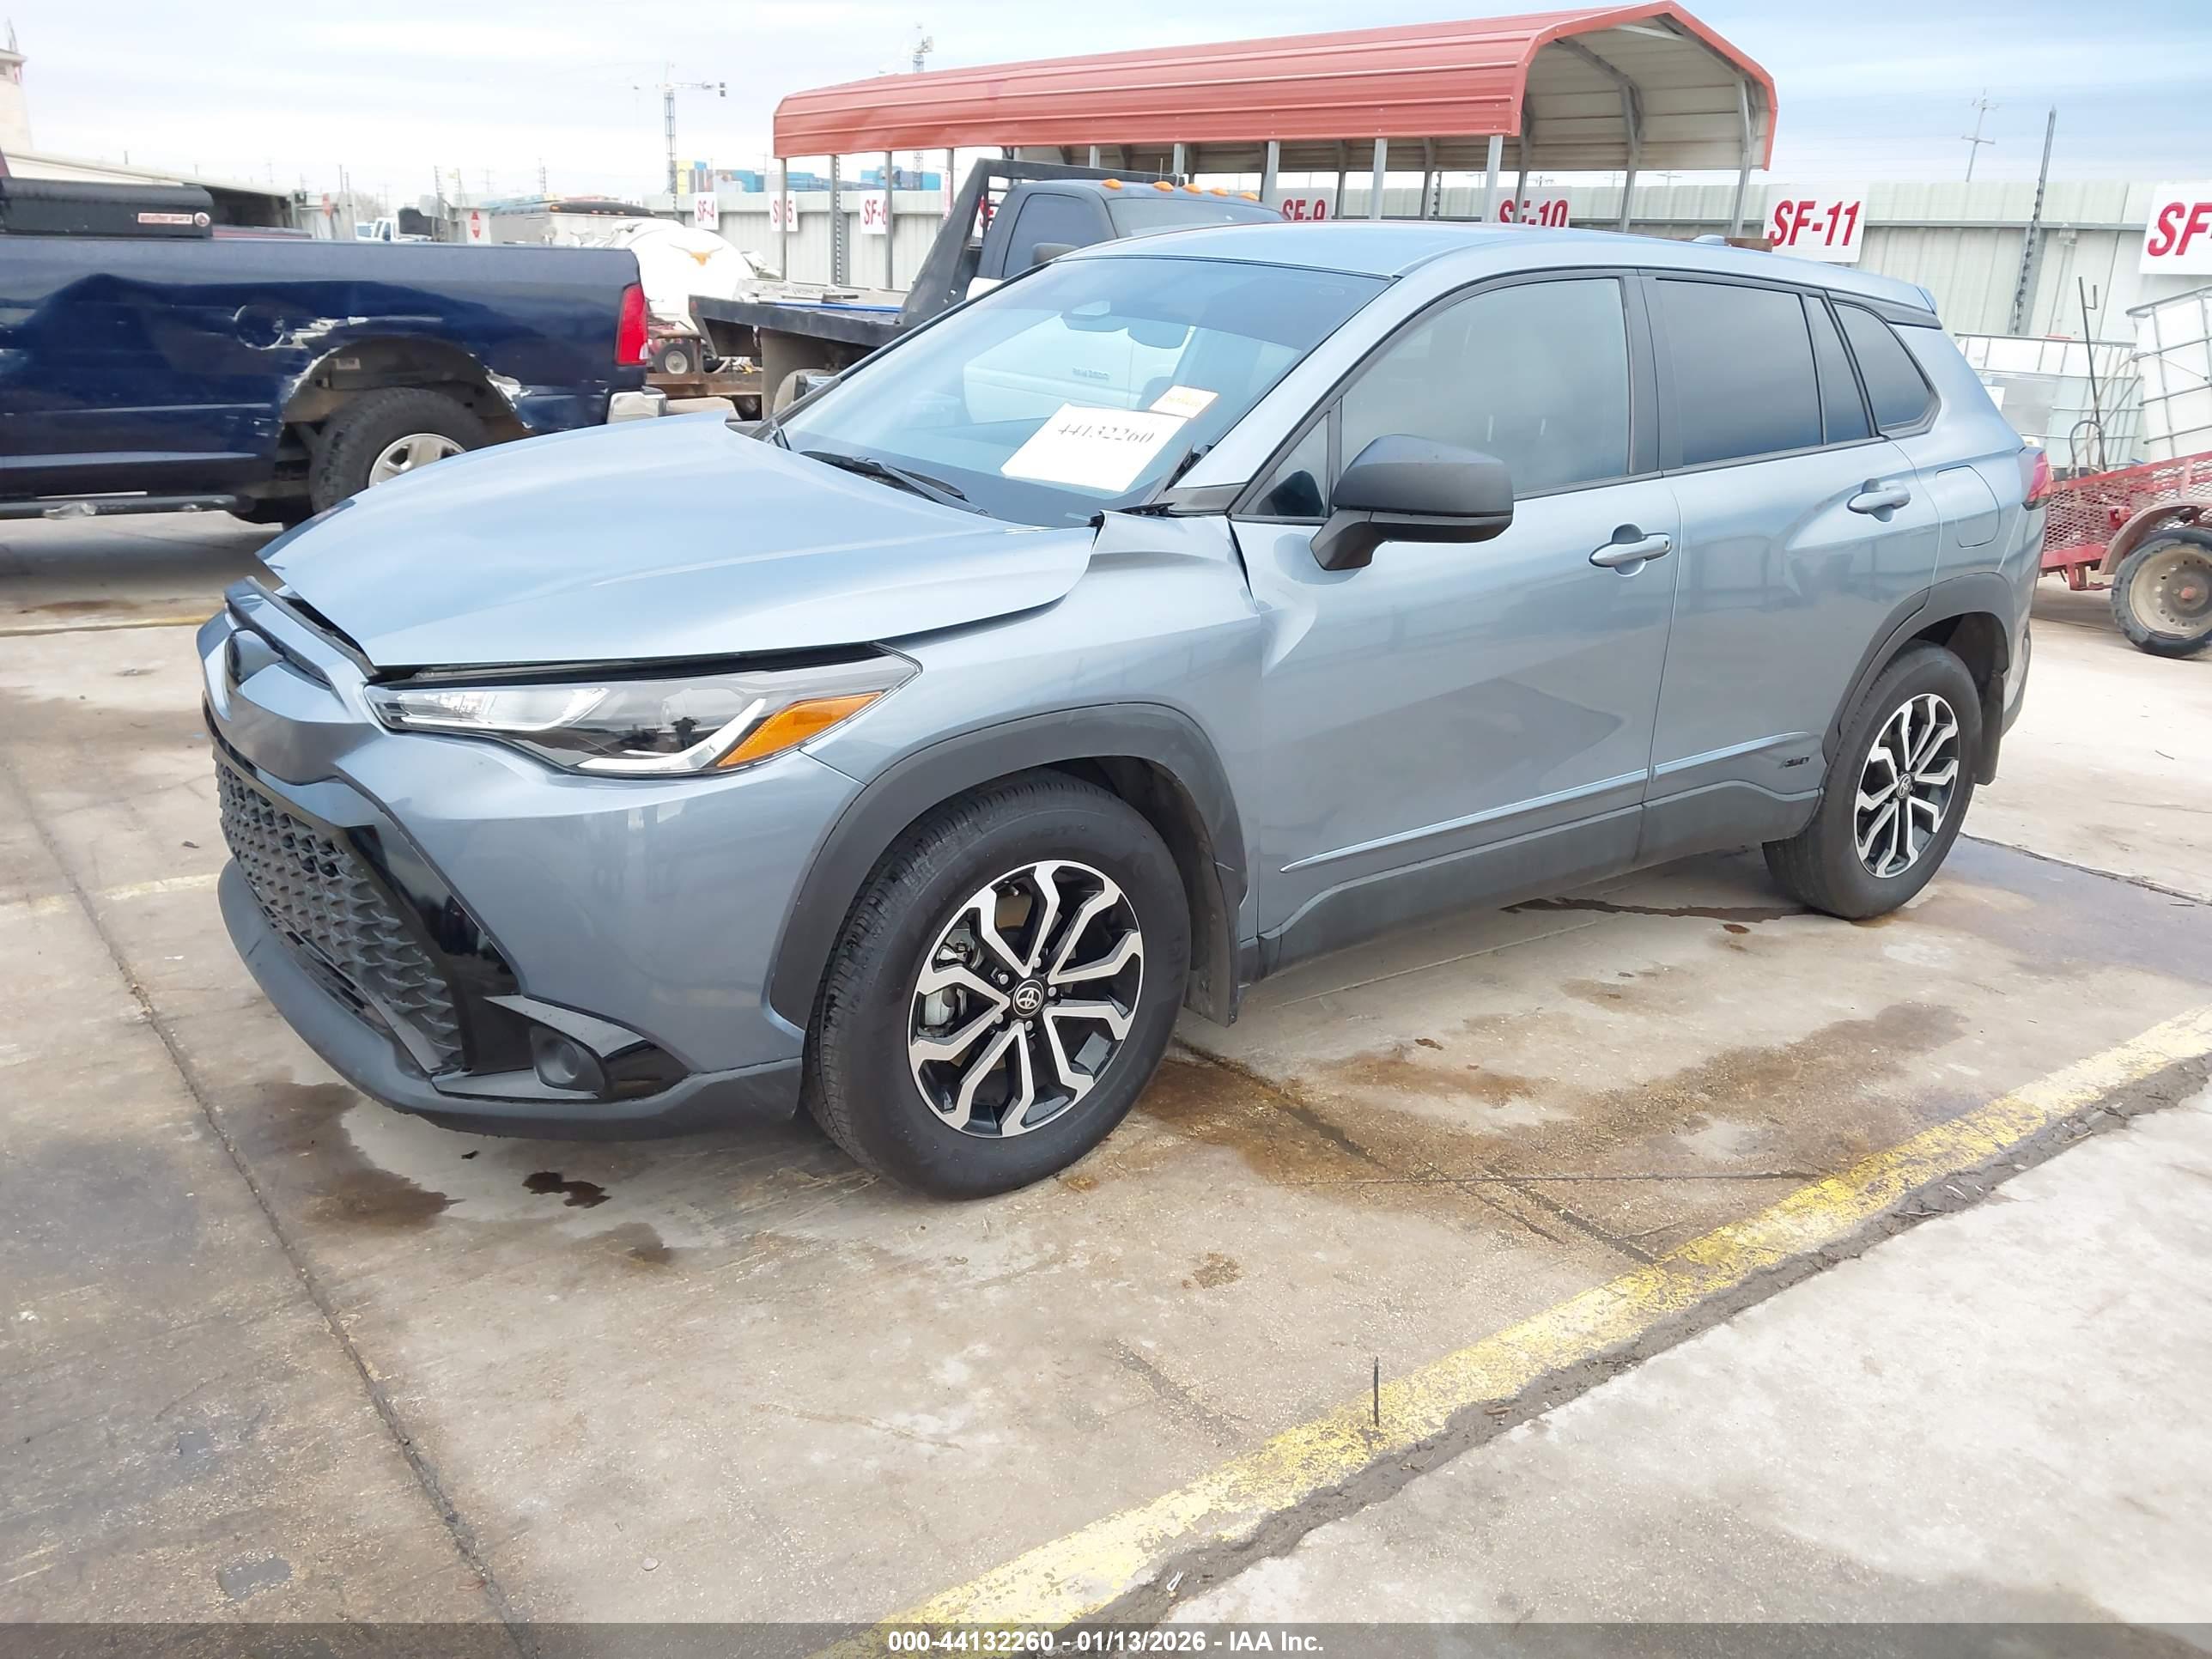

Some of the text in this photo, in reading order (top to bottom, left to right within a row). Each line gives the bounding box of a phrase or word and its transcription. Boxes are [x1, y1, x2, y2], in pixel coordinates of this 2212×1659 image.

[697, 200, 714, 221] SF-4
[1769, 200, 1861, 247] SF-11
[2148, 202, 2212, 256] SF
